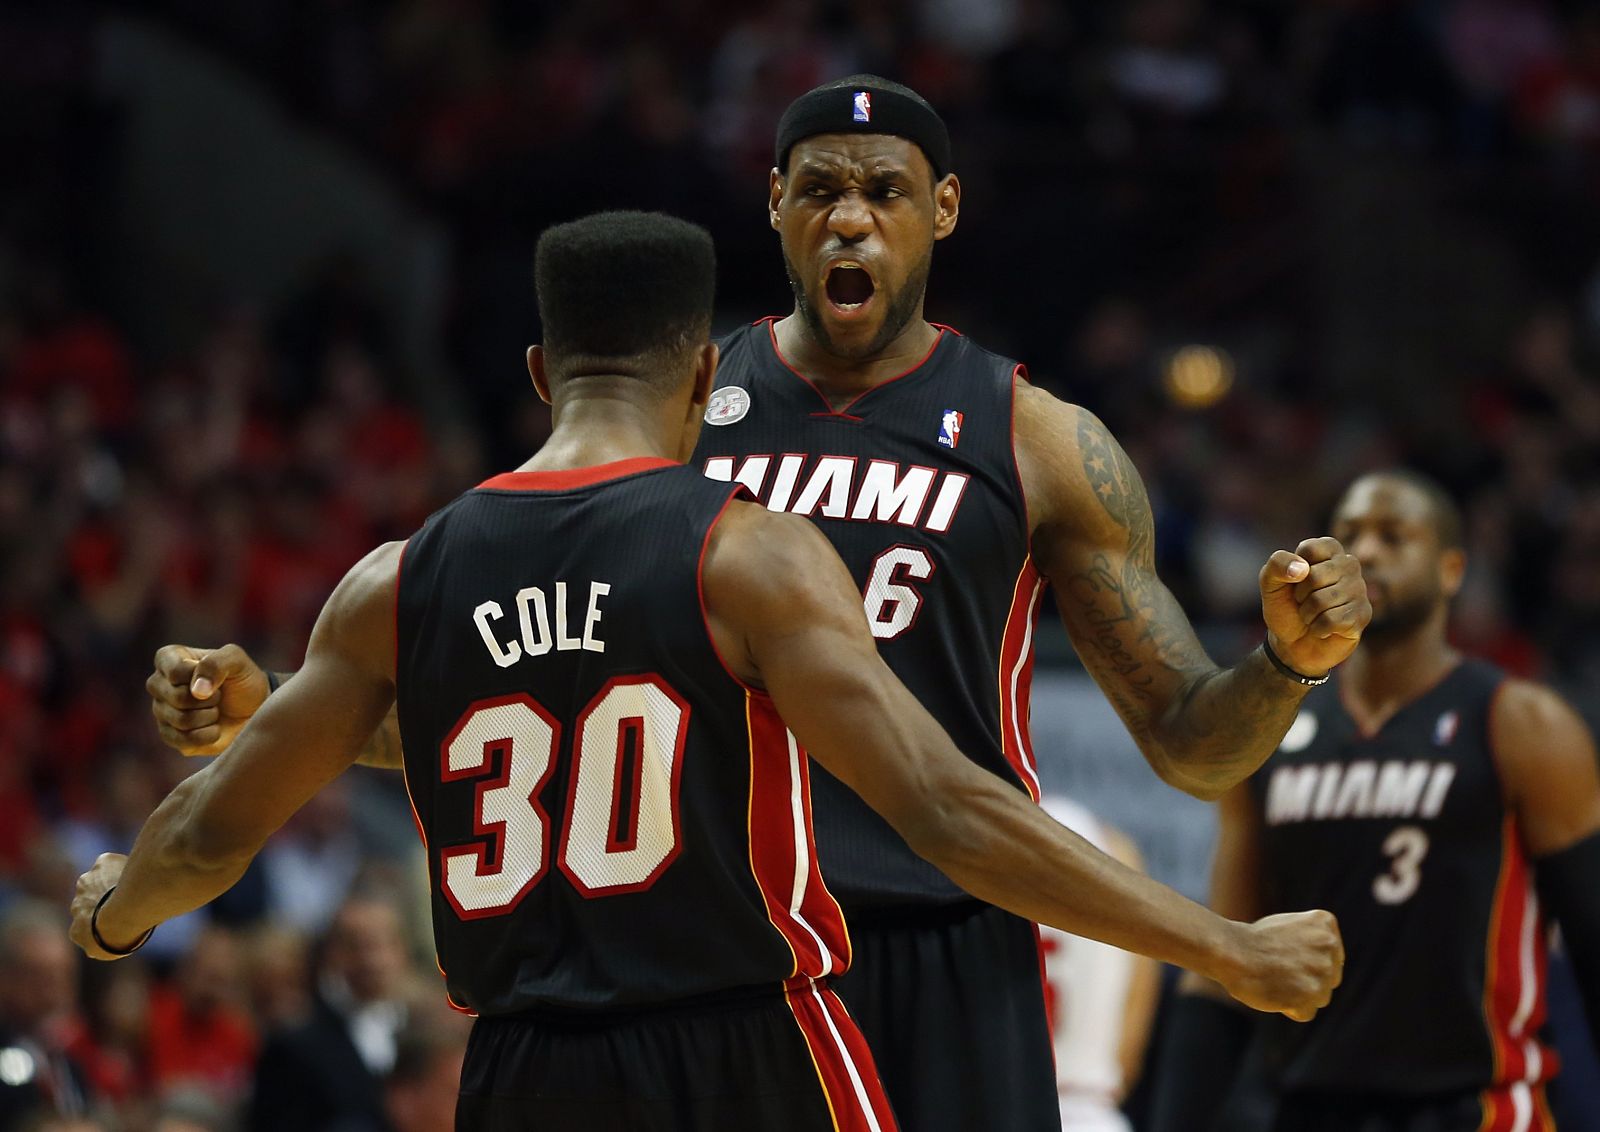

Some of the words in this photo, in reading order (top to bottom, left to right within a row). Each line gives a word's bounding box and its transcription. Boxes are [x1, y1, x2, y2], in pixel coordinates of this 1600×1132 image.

[938, 436, 951, 446] NBA
[472, 580, 611, 668] COLE
[864, 543, 936, 640] 6
[440, 672, 691, 921] 30
[1265, 761, 1456, 825] MIAMI
[1372, 826, 1429, 905] 3
